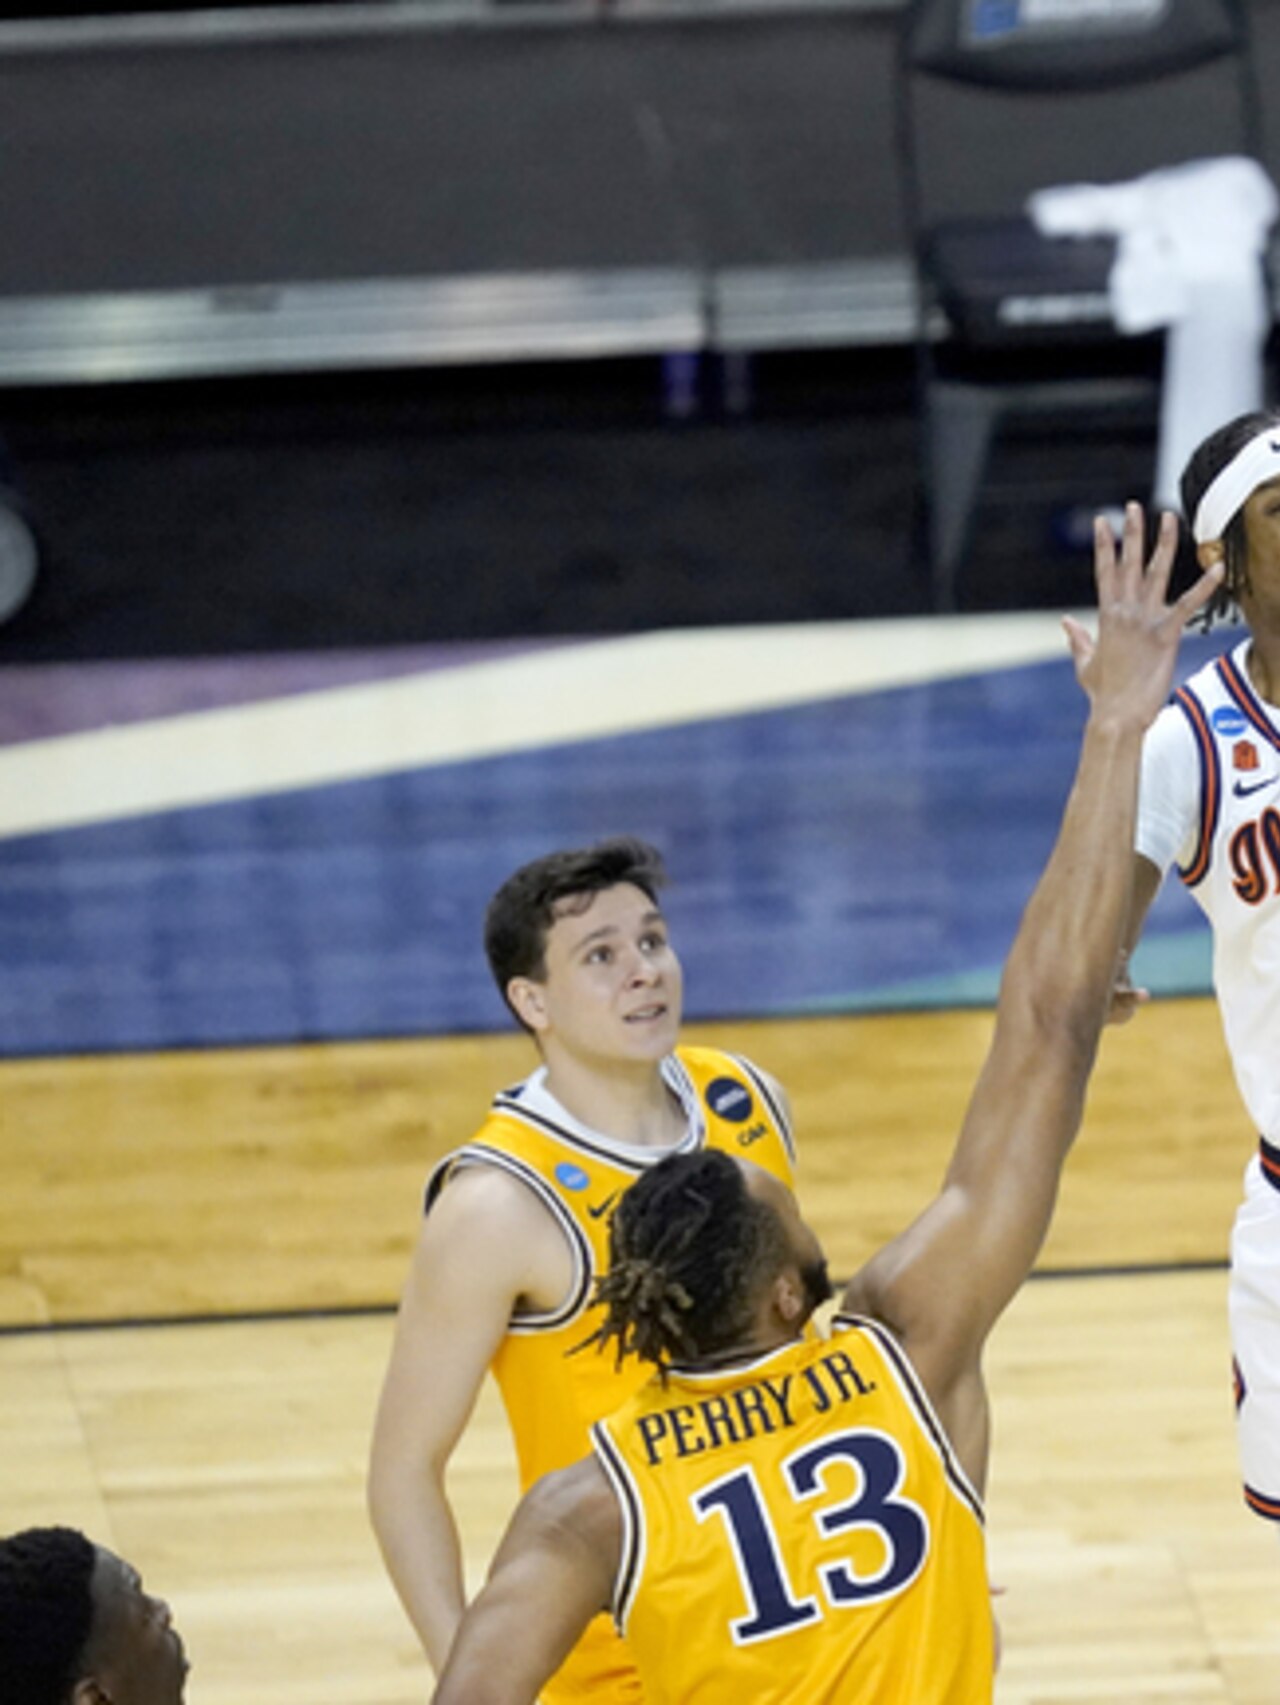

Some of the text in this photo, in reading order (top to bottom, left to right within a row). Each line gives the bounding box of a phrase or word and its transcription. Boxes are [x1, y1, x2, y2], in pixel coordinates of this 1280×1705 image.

[636, 1350, 877, 1466] PERRY JR.
[689, 1427, 931, 1647] 13
